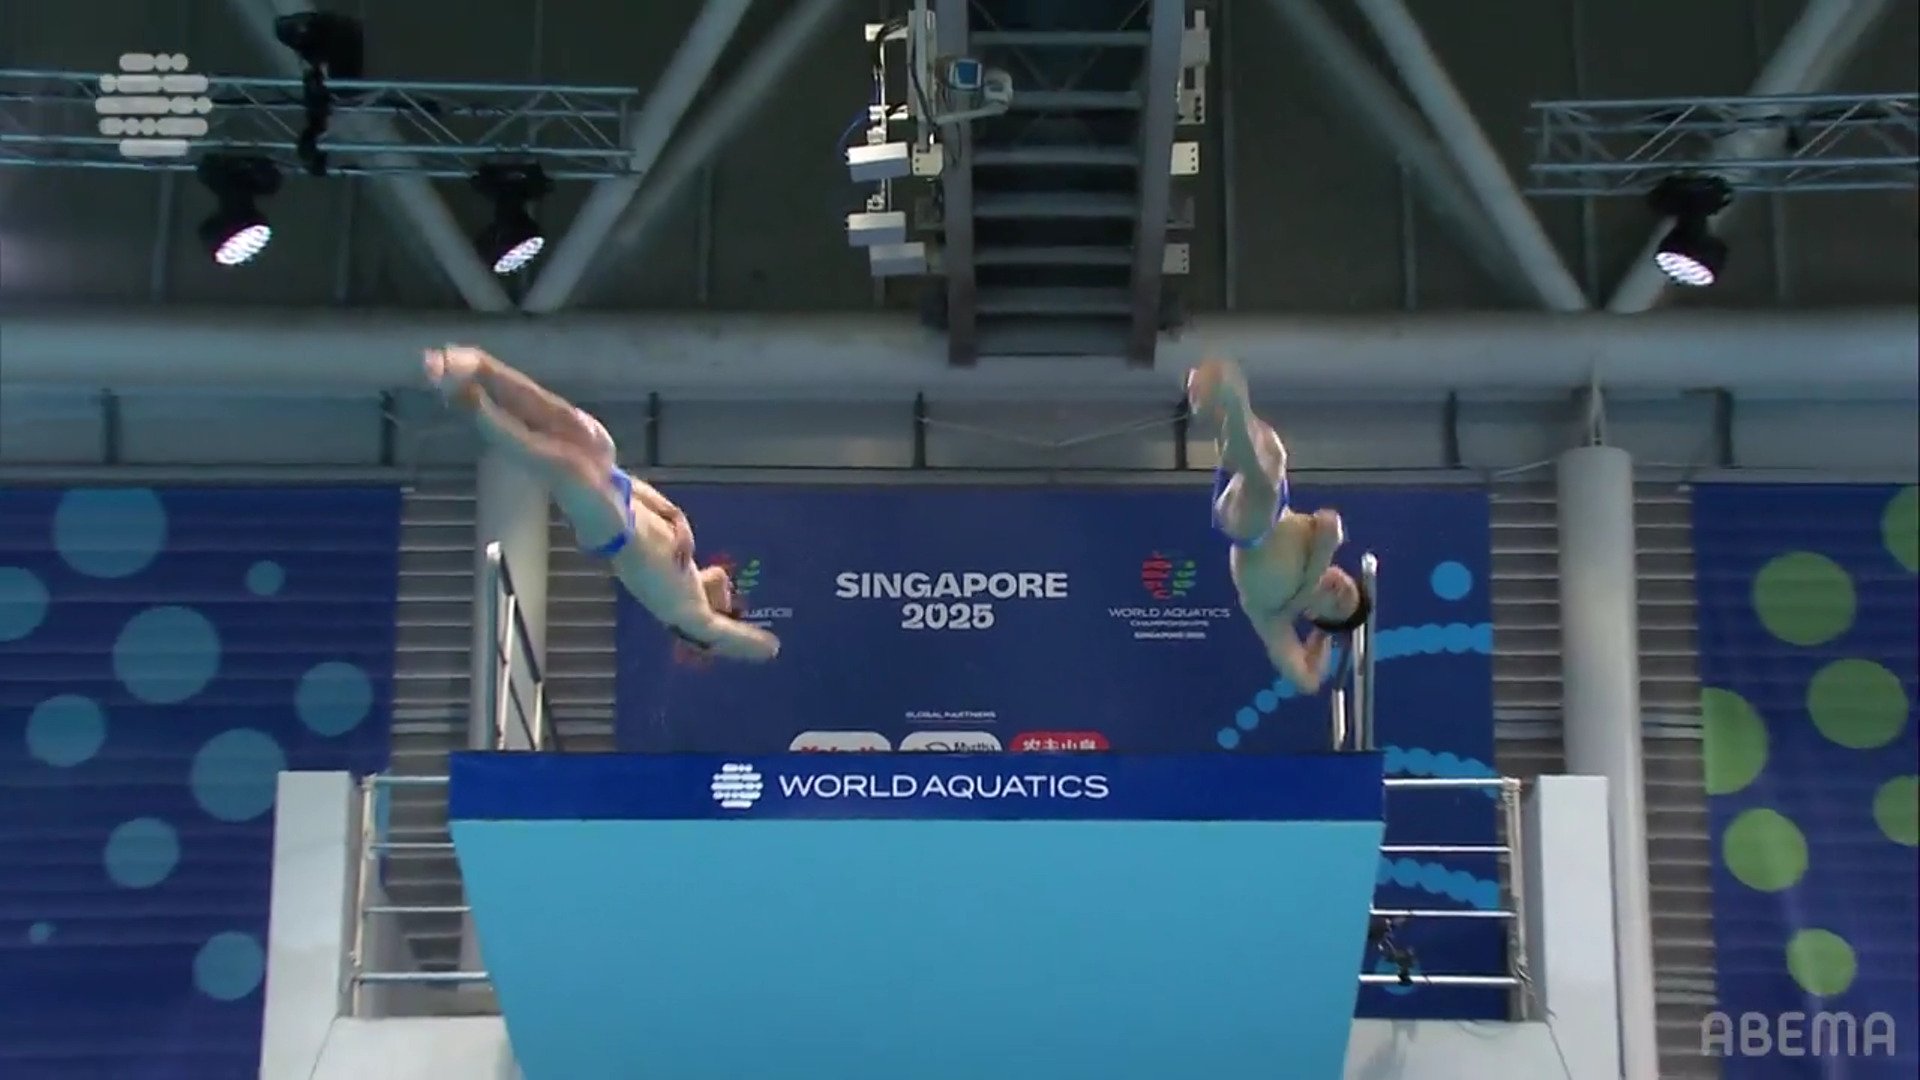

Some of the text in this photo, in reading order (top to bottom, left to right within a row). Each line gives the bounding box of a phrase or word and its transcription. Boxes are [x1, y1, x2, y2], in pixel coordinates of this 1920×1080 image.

[835, 572, 1068, 599] SINGAPORE
[901, 603, 995, 630] 2025
[1108, 608, 1231, 618] WORLD AQUATICS
[778, 775, 1110, 799] WORLD AQUATICS
